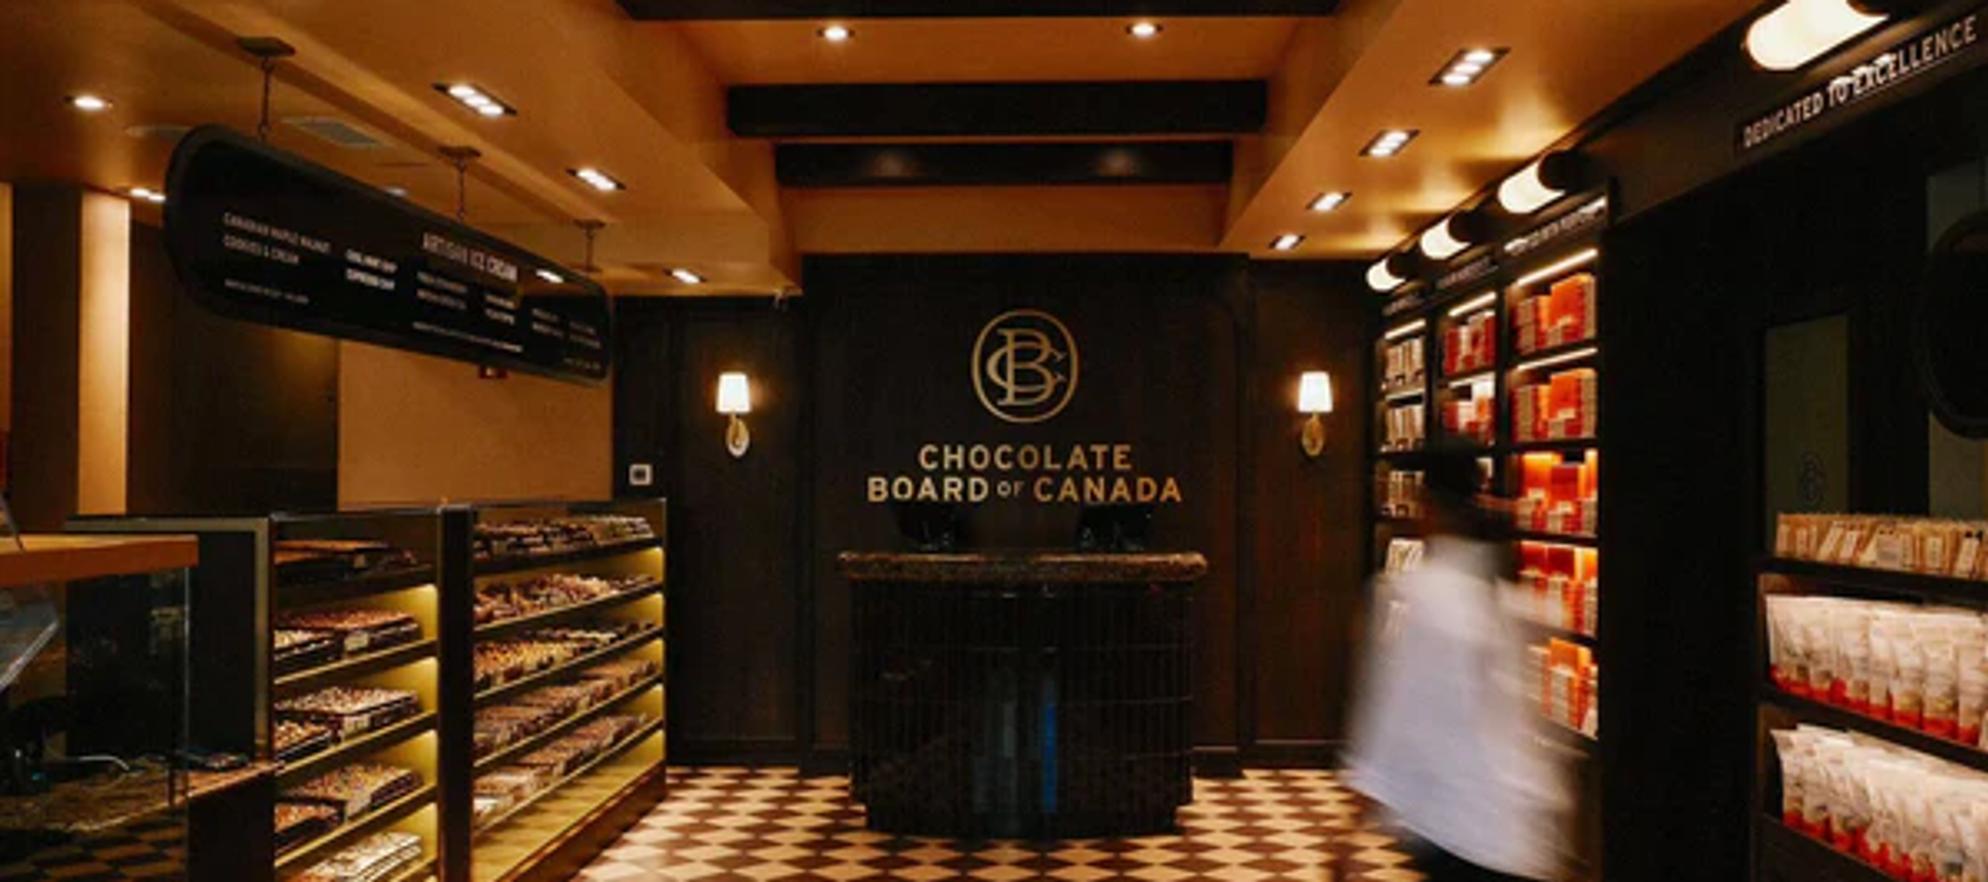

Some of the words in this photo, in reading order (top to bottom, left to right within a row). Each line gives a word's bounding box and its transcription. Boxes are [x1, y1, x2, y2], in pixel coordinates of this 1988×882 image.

[1743, 92, 1825, 148] DEDICATED
[1828, 80, 1849, 107] TO
[1852, 15, 1977, 95] EXCELLENCE
[270, 227, 299, 246] MAPLE
[423, 231, 468, 264] ARTISAN
[470, 249, 485, 271] ICE
[486, 252, 518, 282] CREAM
[918, 444, 1132, 470] CHOCOLATE
[867, 476, 989, 501] BOARD
[996, 480, 1024, 497] OF
[1033, 476, 1182, 502] CANADA
